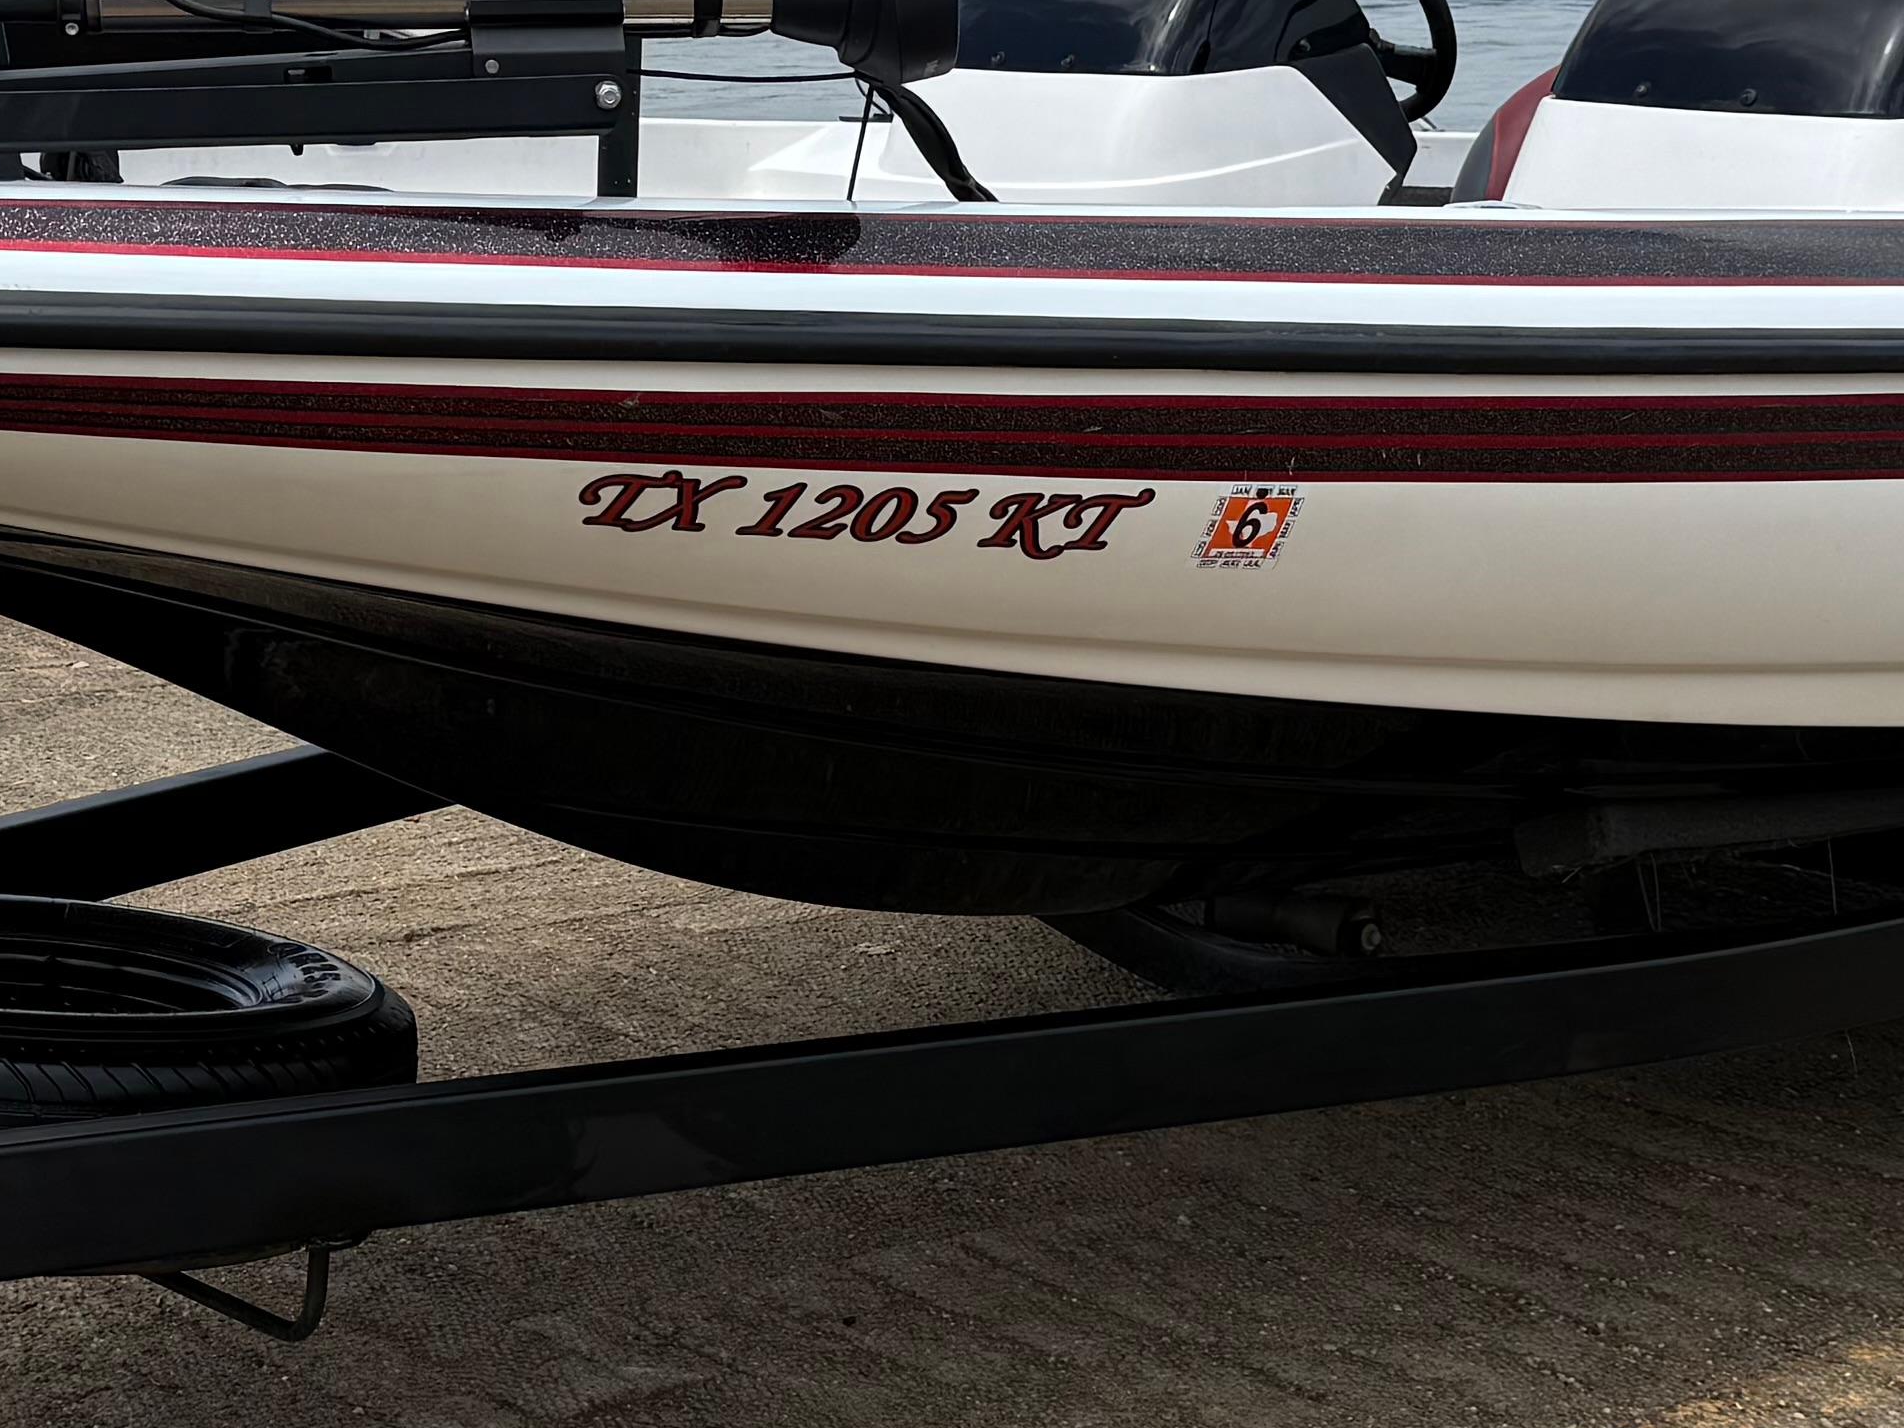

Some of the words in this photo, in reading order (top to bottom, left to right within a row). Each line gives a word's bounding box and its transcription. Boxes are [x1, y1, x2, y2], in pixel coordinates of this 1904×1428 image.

[578, 469, 748, 533] TX
[734, 481, 980, 545] 1205
[976, 487, 1156, 561] KT
[1232, 501, 1269, 549] 6
